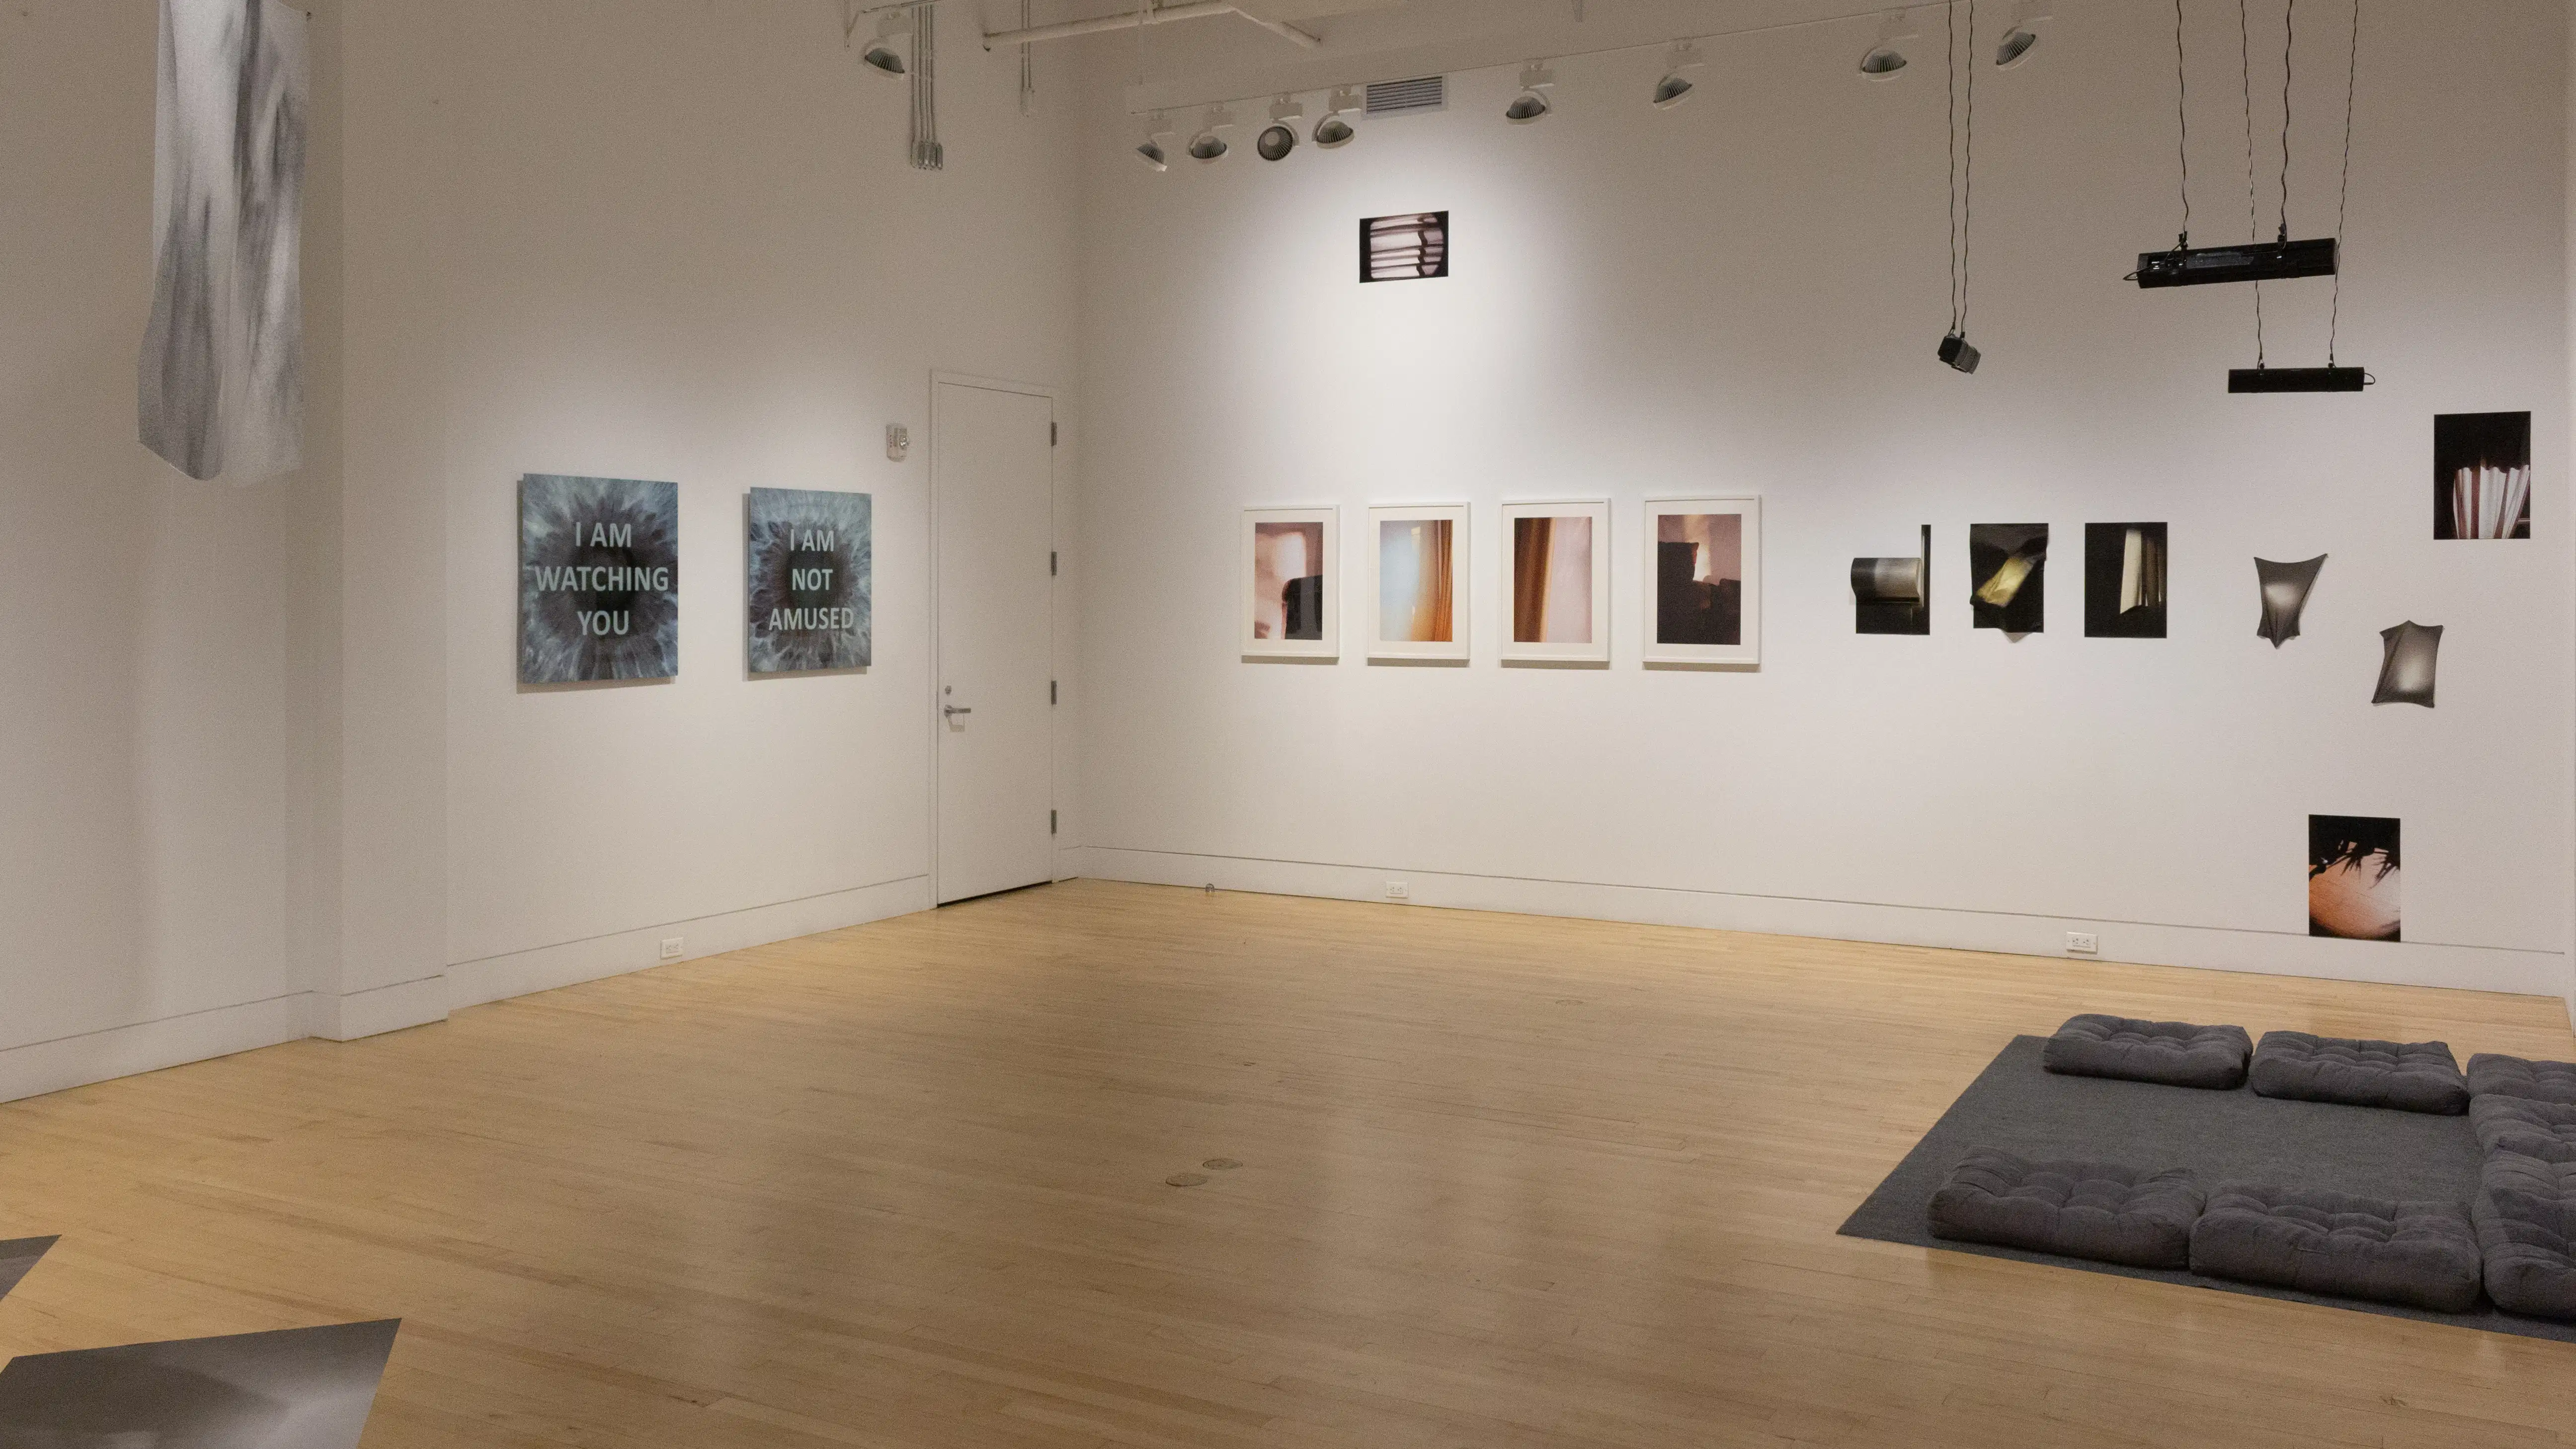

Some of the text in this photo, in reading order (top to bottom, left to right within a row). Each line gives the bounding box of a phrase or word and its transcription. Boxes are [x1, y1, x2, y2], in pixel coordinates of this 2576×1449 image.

[575, 522, 632, 547] I AM
[790, 529, 834, 552] I AM
[534, 566, 668, 591] WATCHING
[792, 568, 833, 591] NOT
[576, 610, 629, 636] YOU
[768, 607, 854, 631] AMUSED
